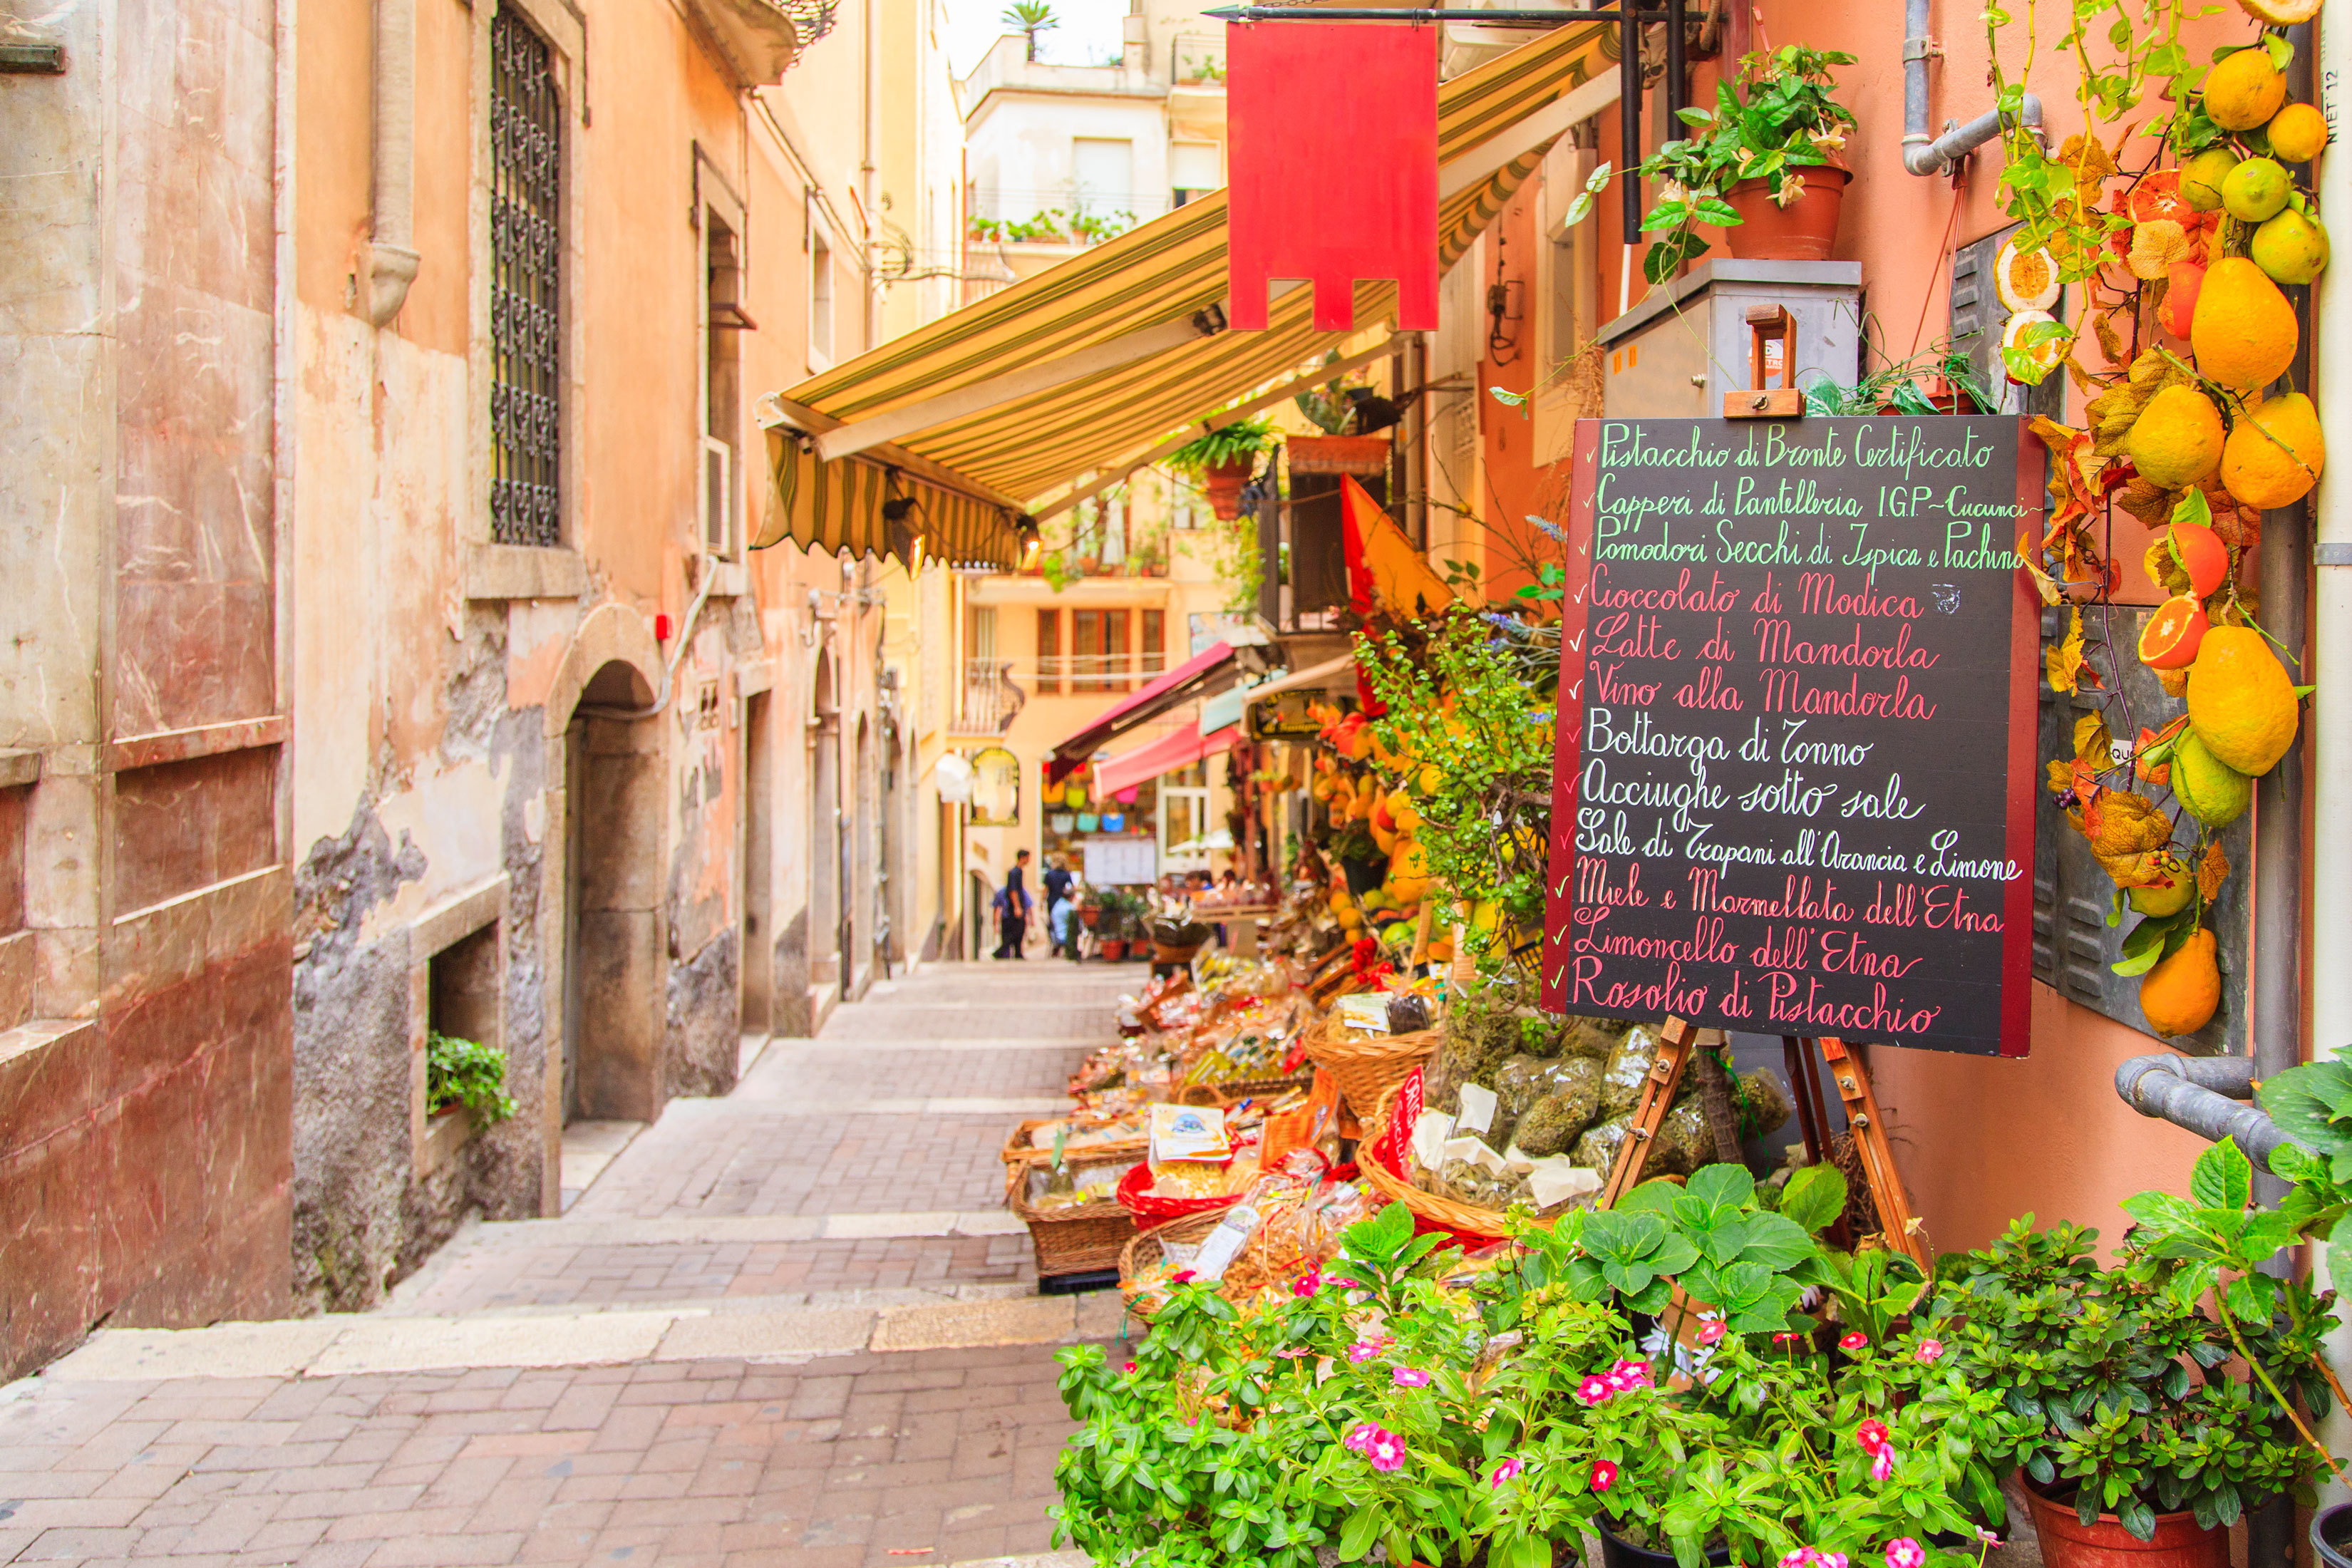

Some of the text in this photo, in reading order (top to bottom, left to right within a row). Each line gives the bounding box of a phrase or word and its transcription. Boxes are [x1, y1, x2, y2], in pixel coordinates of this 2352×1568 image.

[1601, 423, 1994, 480] Pistacchio di Bronte Certificato
[1597, 473, 1693, 532] Capperi
[1701, 480, 1726, 515] di
[1735, 476, 1863, 517] Pantelleria
[1595, 515, 2032, 584] Pomodori Secchi di Ispica e Pachino
[1590, 563, 1925, 619] Cioccolato di Modica
[1592, 612, 1940, 669] Latte di Mandorla
[1589, 660, 1937, 720] Vino alla Mandorla
[1588, 707, 1874, 776] Bottarga di Tonno
[1583, 758, 1927, 832] Acciughe sotto sale
[1575, 807, 2022, 881] Sale di Trapani all'Arancia e Limone
[1577, 855, 2004, 932] Miele e Marmellata dell'Etna
[1574, 906, 1923, 978] Limoncello dell'Etna
[1572, 955, 1940, 1033] Rosolio di Pistacchio
